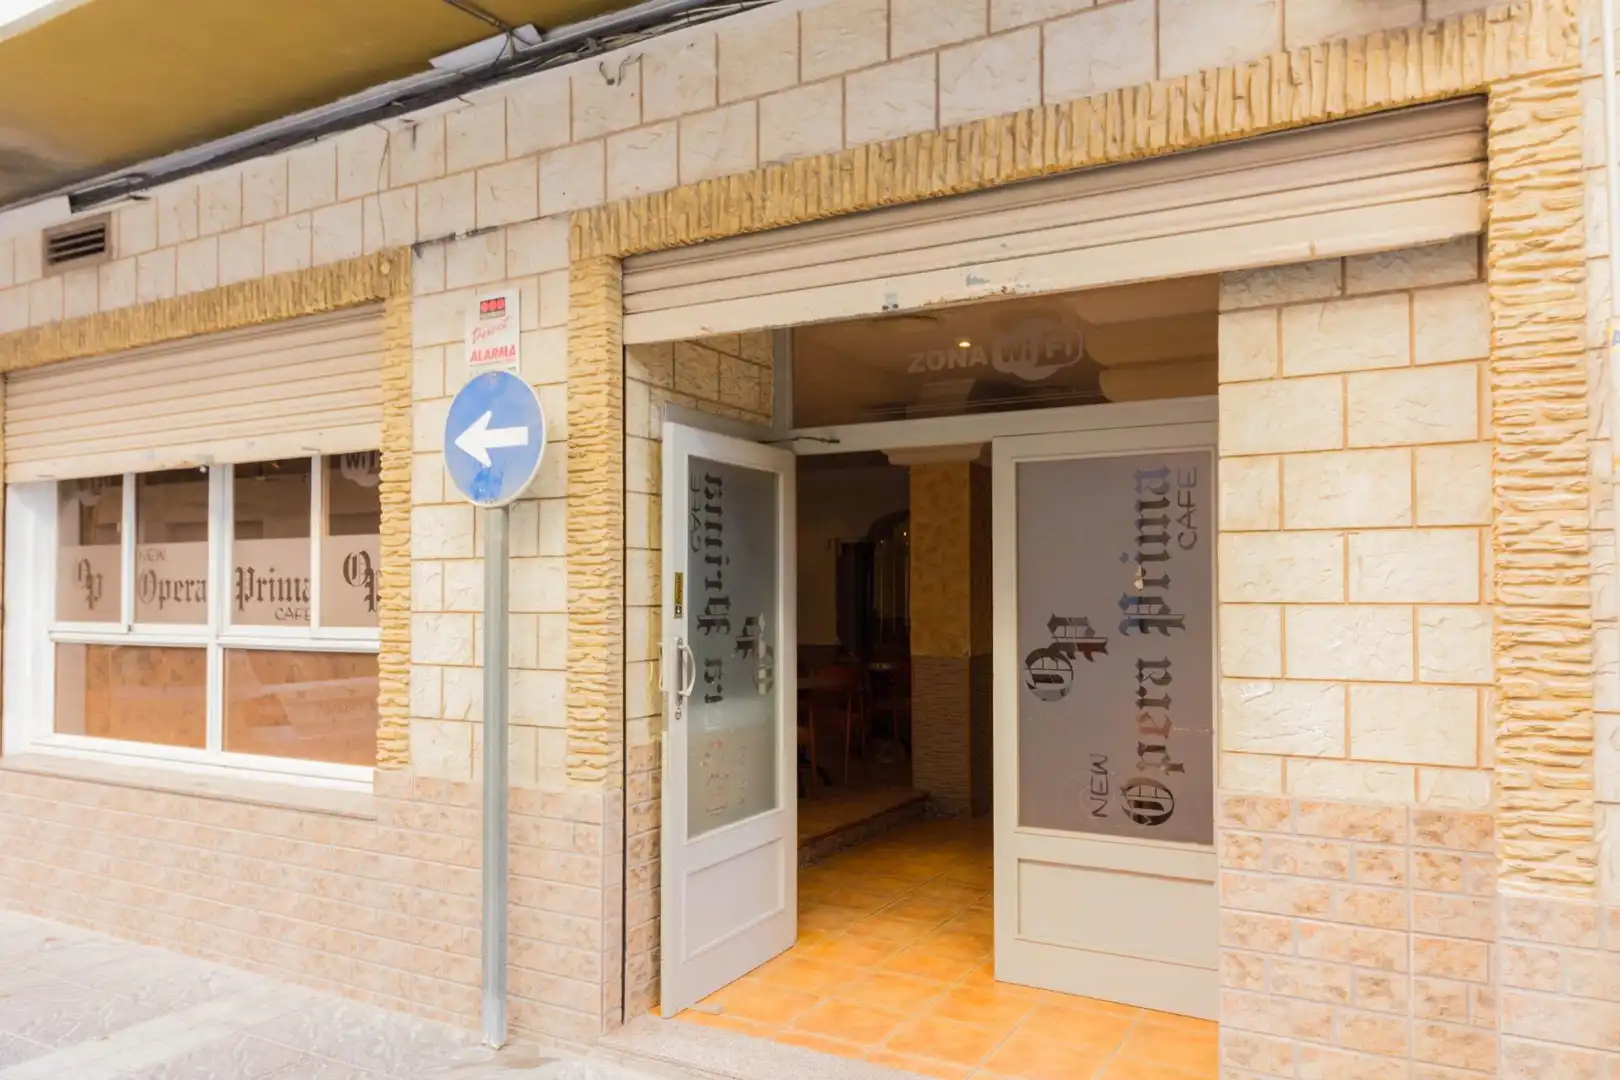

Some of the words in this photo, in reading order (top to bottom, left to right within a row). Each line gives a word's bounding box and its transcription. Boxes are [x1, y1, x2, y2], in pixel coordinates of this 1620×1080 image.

[470, 344, 516, 362] ALARMA
[907, 346, 988, 374] ZONA
[1176, 465, 1198, 550] CAFE
[138, 549, 166, 561] NEW
[1118, 466, 1186, 637] Prima
[138, 569, 207, 610] Opera
[234, 566, 310, 612] Prima
[275, 607, 310, 621] CAFE
[1119, 657, 1186, 827] Opera
[1090, 753, 1109, 818] NEW
